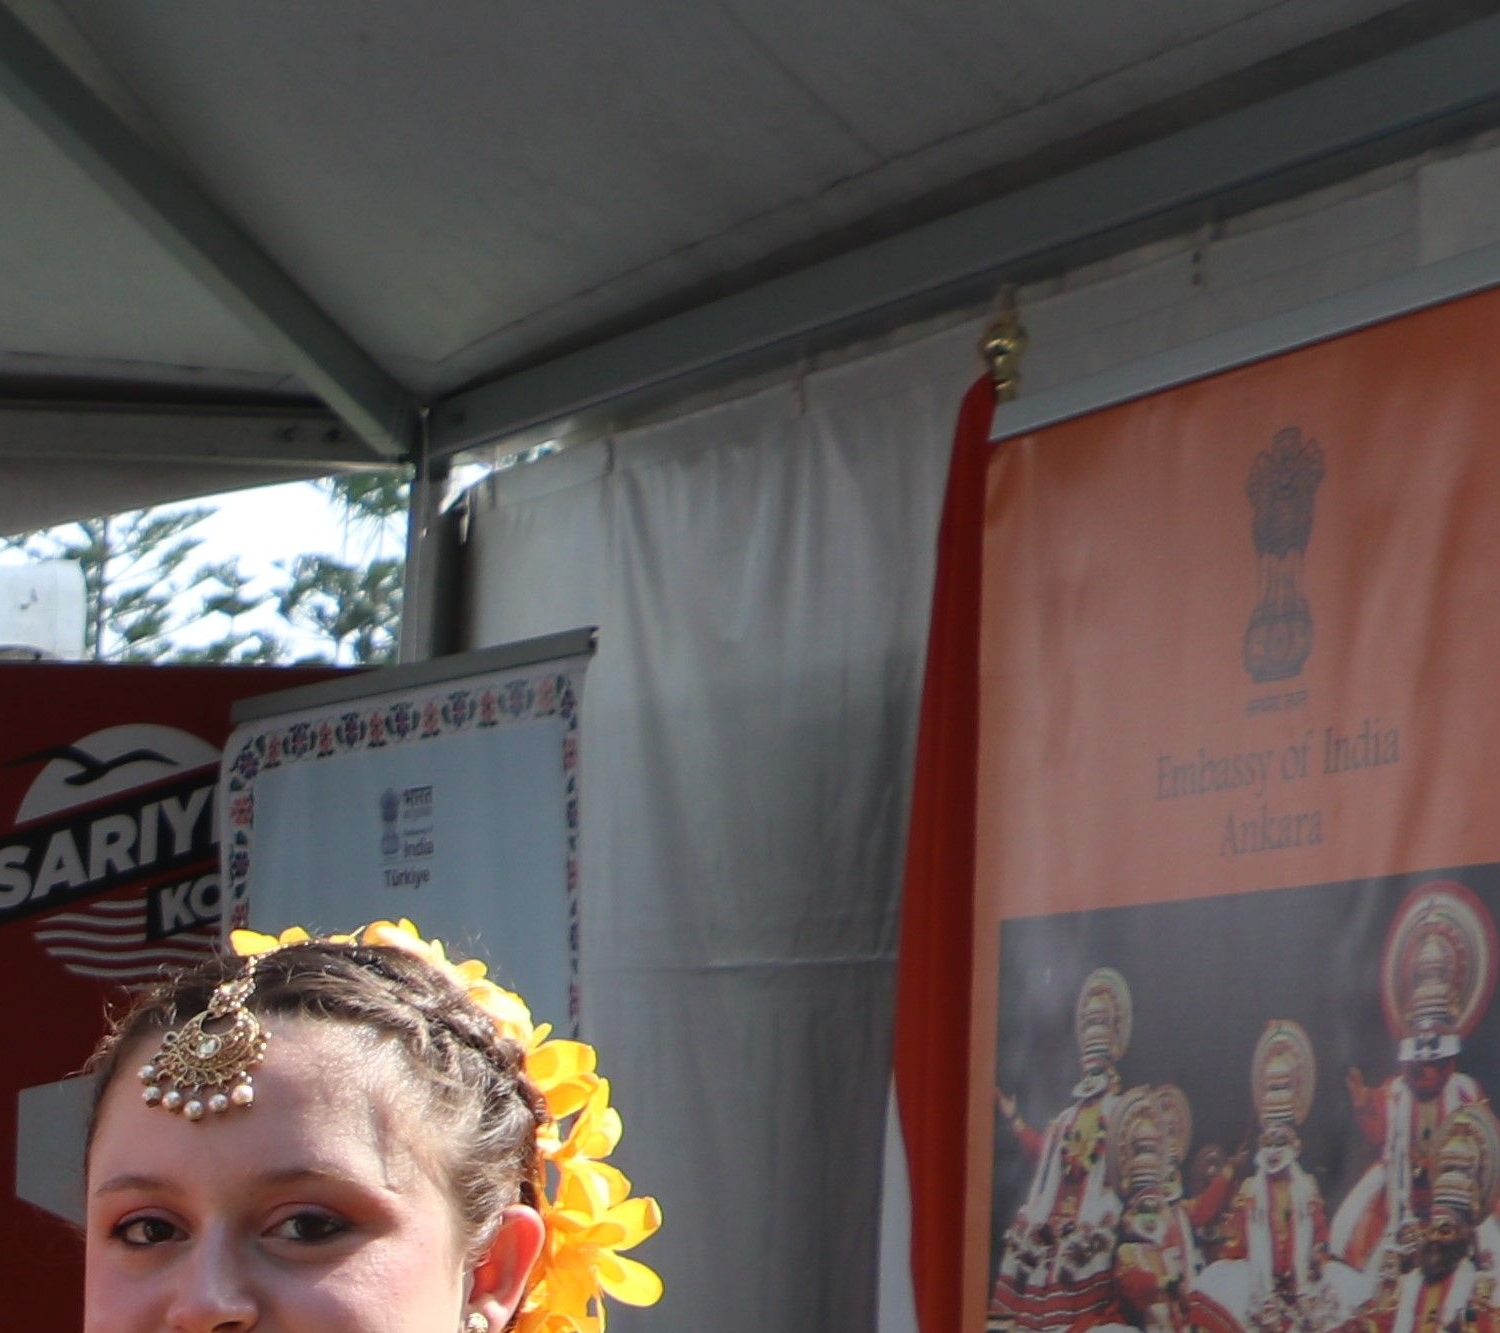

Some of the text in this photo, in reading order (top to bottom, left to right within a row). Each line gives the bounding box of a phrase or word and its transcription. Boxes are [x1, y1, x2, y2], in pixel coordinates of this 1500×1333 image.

[1156, 716, 1400, 800] Embassy of India
[403, 838, 434, 858] India
[1219, 803, 1324, 857] Ankara
[160, 872, 222, 933] KO
[383, 868, 431, 889] Türkiye
